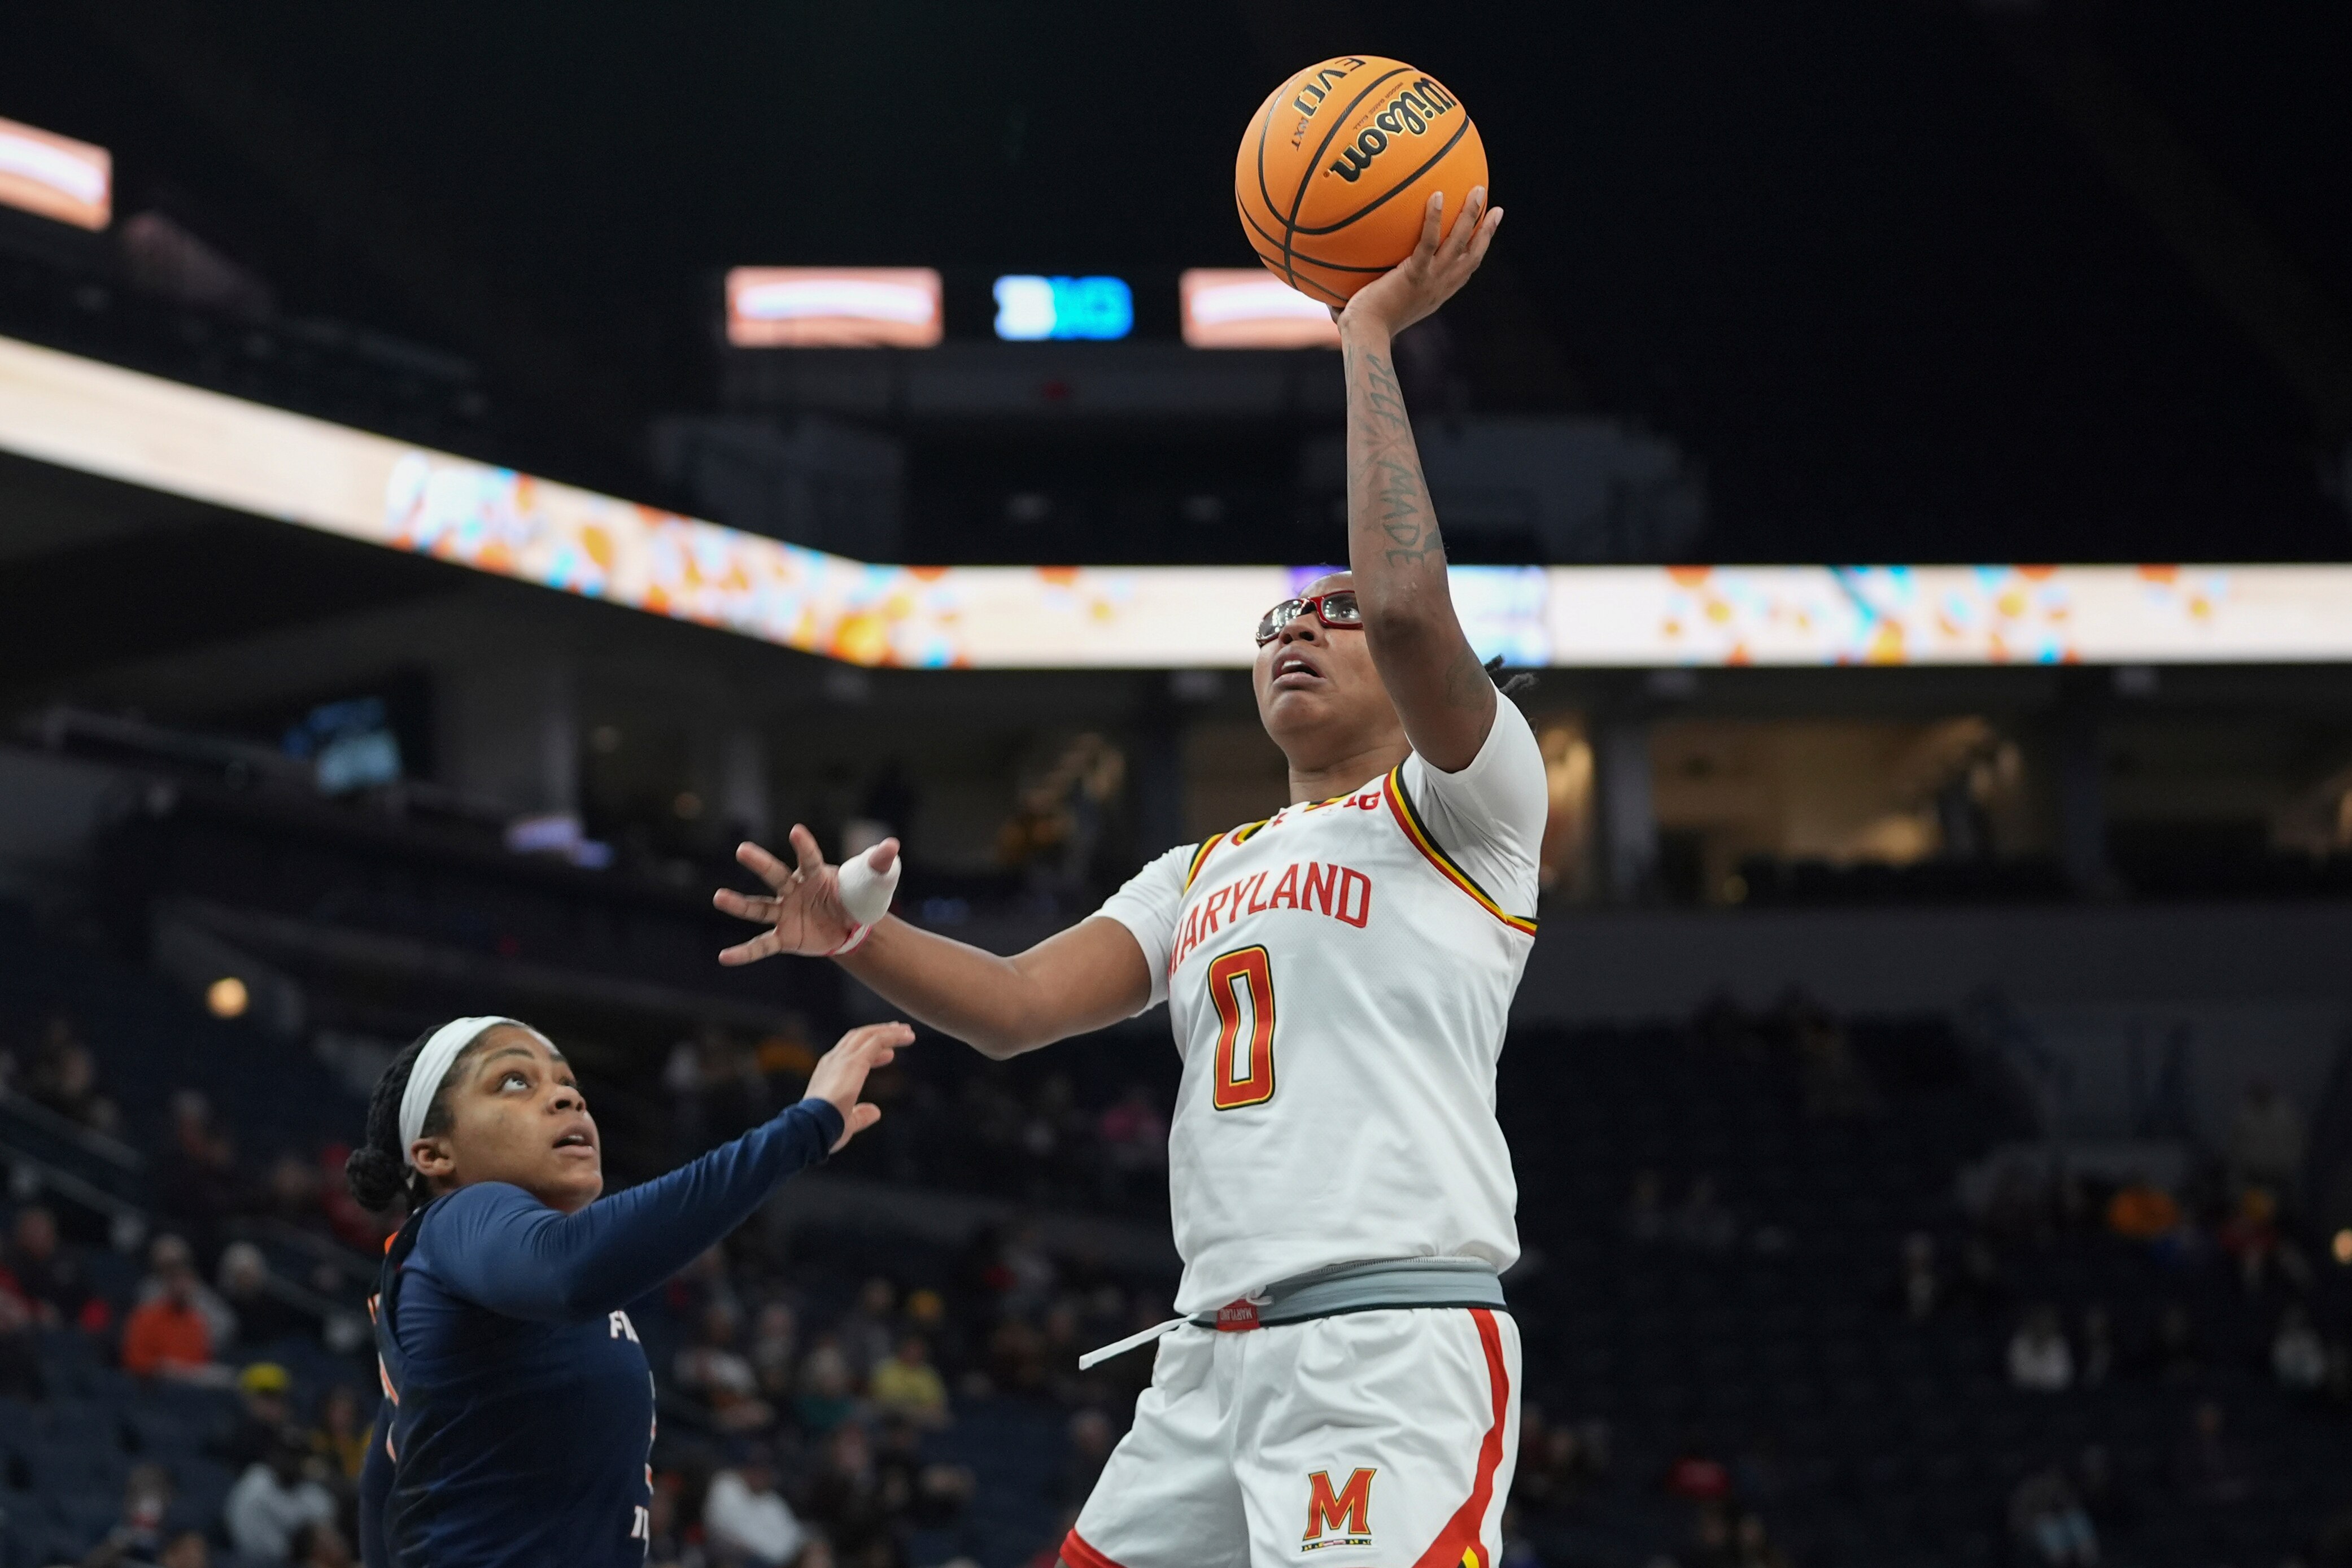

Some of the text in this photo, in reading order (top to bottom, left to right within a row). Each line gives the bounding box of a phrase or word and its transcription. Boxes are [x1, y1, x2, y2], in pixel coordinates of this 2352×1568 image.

[1293, 58, 1366, 118] EVO
[1328, 77, 1458, 184] Wilson
[1377, 460, 1425, 567] MADE
[1207, 944, 1276, 1111] 0
[1302, 1467, 1378, 1541] M
